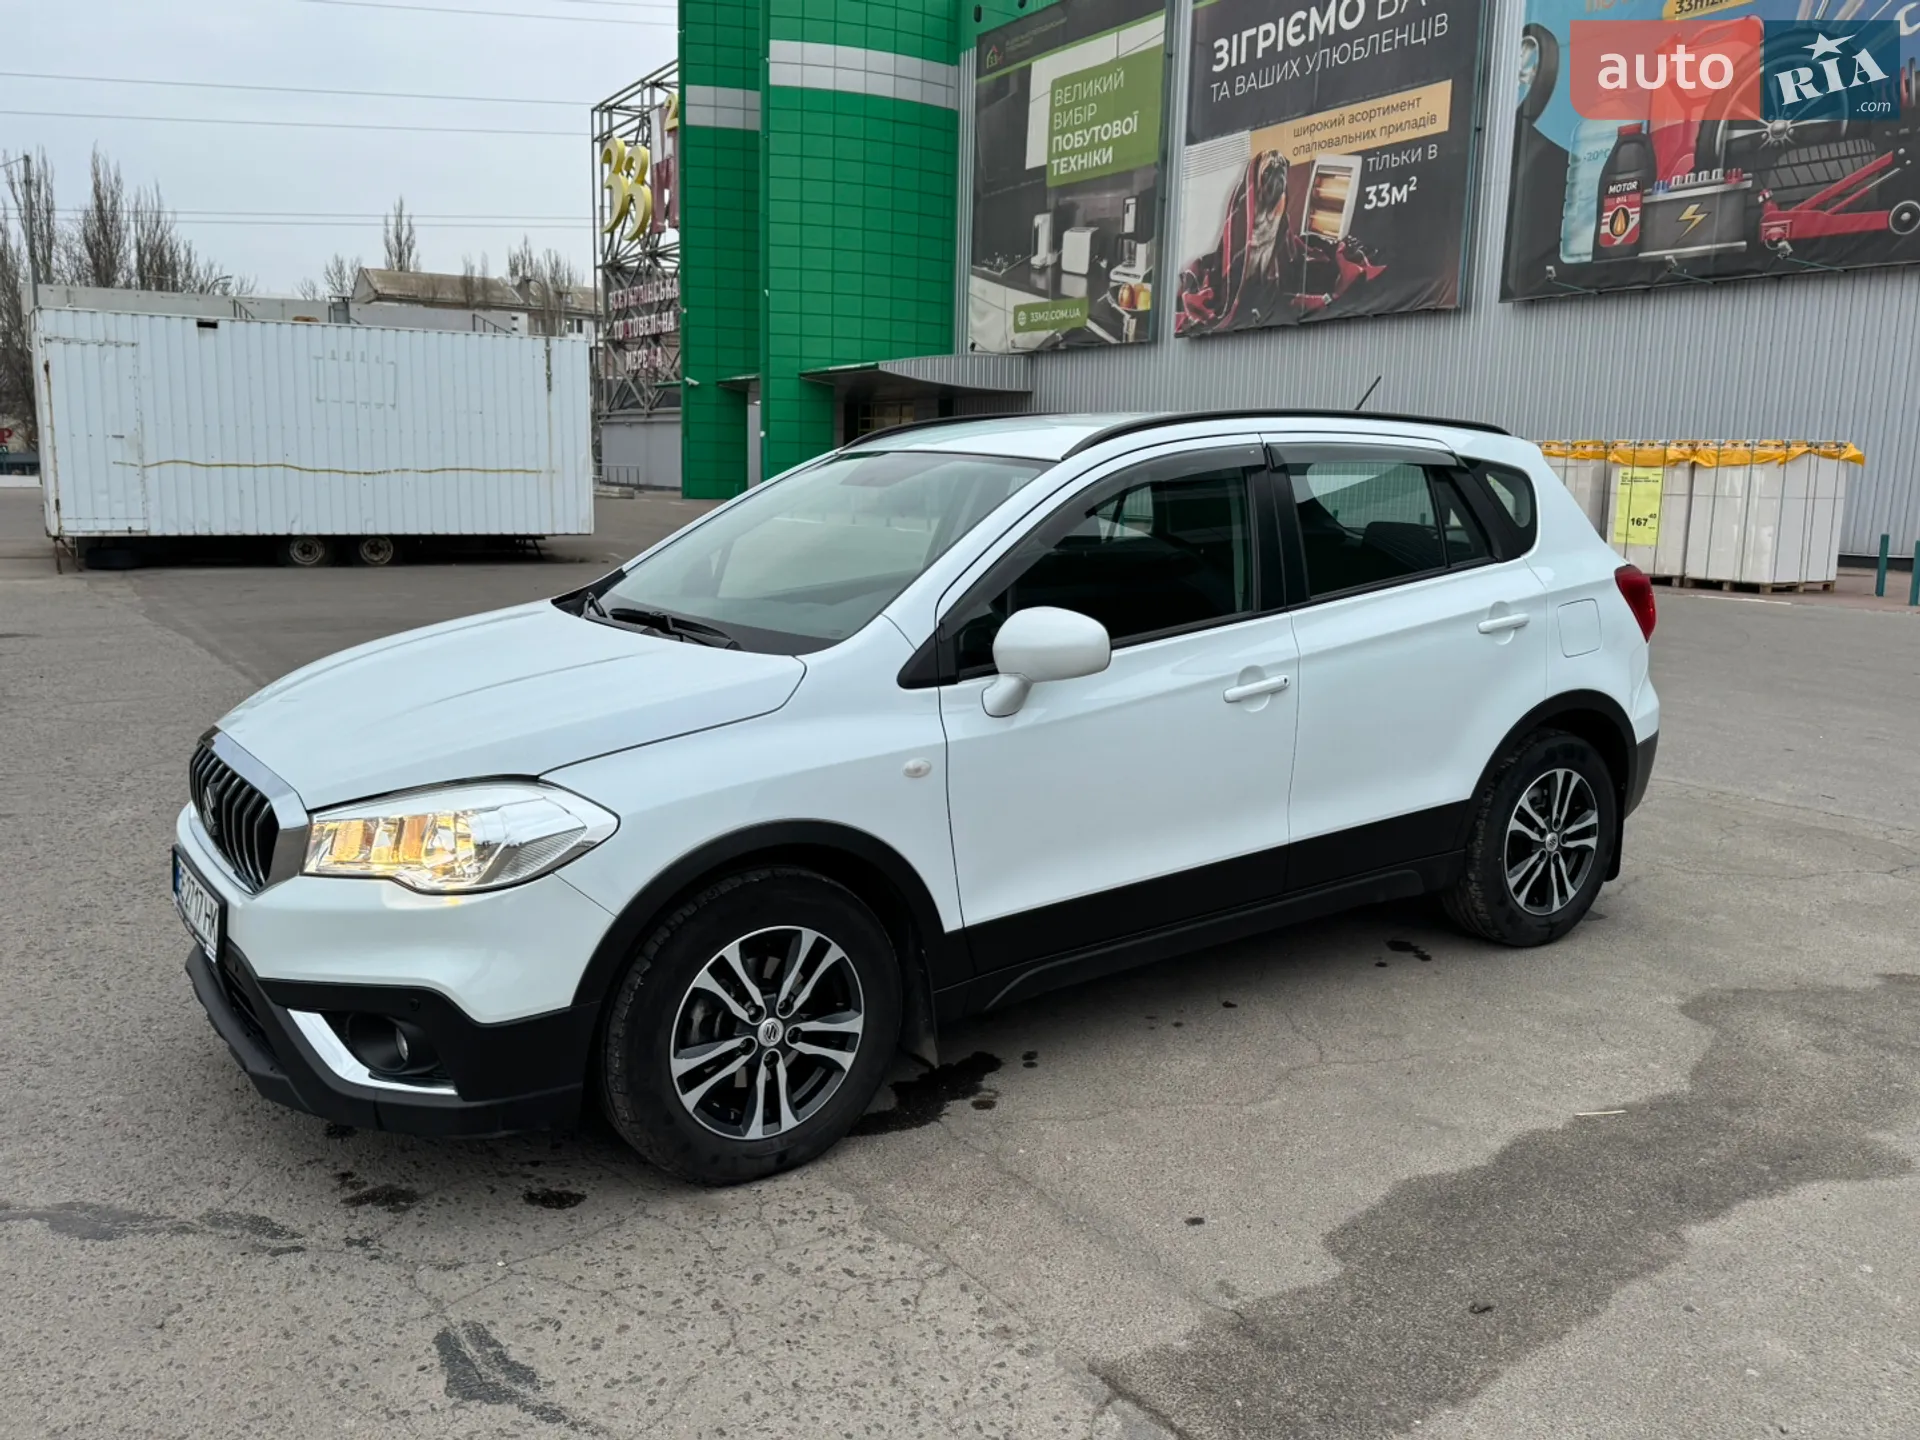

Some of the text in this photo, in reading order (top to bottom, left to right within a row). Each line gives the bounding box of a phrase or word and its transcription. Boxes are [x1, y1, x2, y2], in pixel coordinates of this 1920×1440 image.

[1212, 0, 1366, 72] ЗІГРІЄМО
[1210, 13, 1449, 103] ТА ВАШИХ УЛЮБЛЕНЦІВ
[1054, 67, 1125, 107] ВЕЛИКИЙ
[1051, 110, 1139, 154] ПОБУТОВОЇ
[1053, 102, 1098, 131] ВИБІР
[1291, 112, 1438, 157] опалювальних приладів
[1292, 97, 1423, 138] широкий асортимент
[1050, 145, 1114, 176] ТЕХНІКИ
[1367, 147, 1422, 173] тільки
[1607, 181, 1639, 195] MOTOR
[1631, 517, 1648, 527] 167
